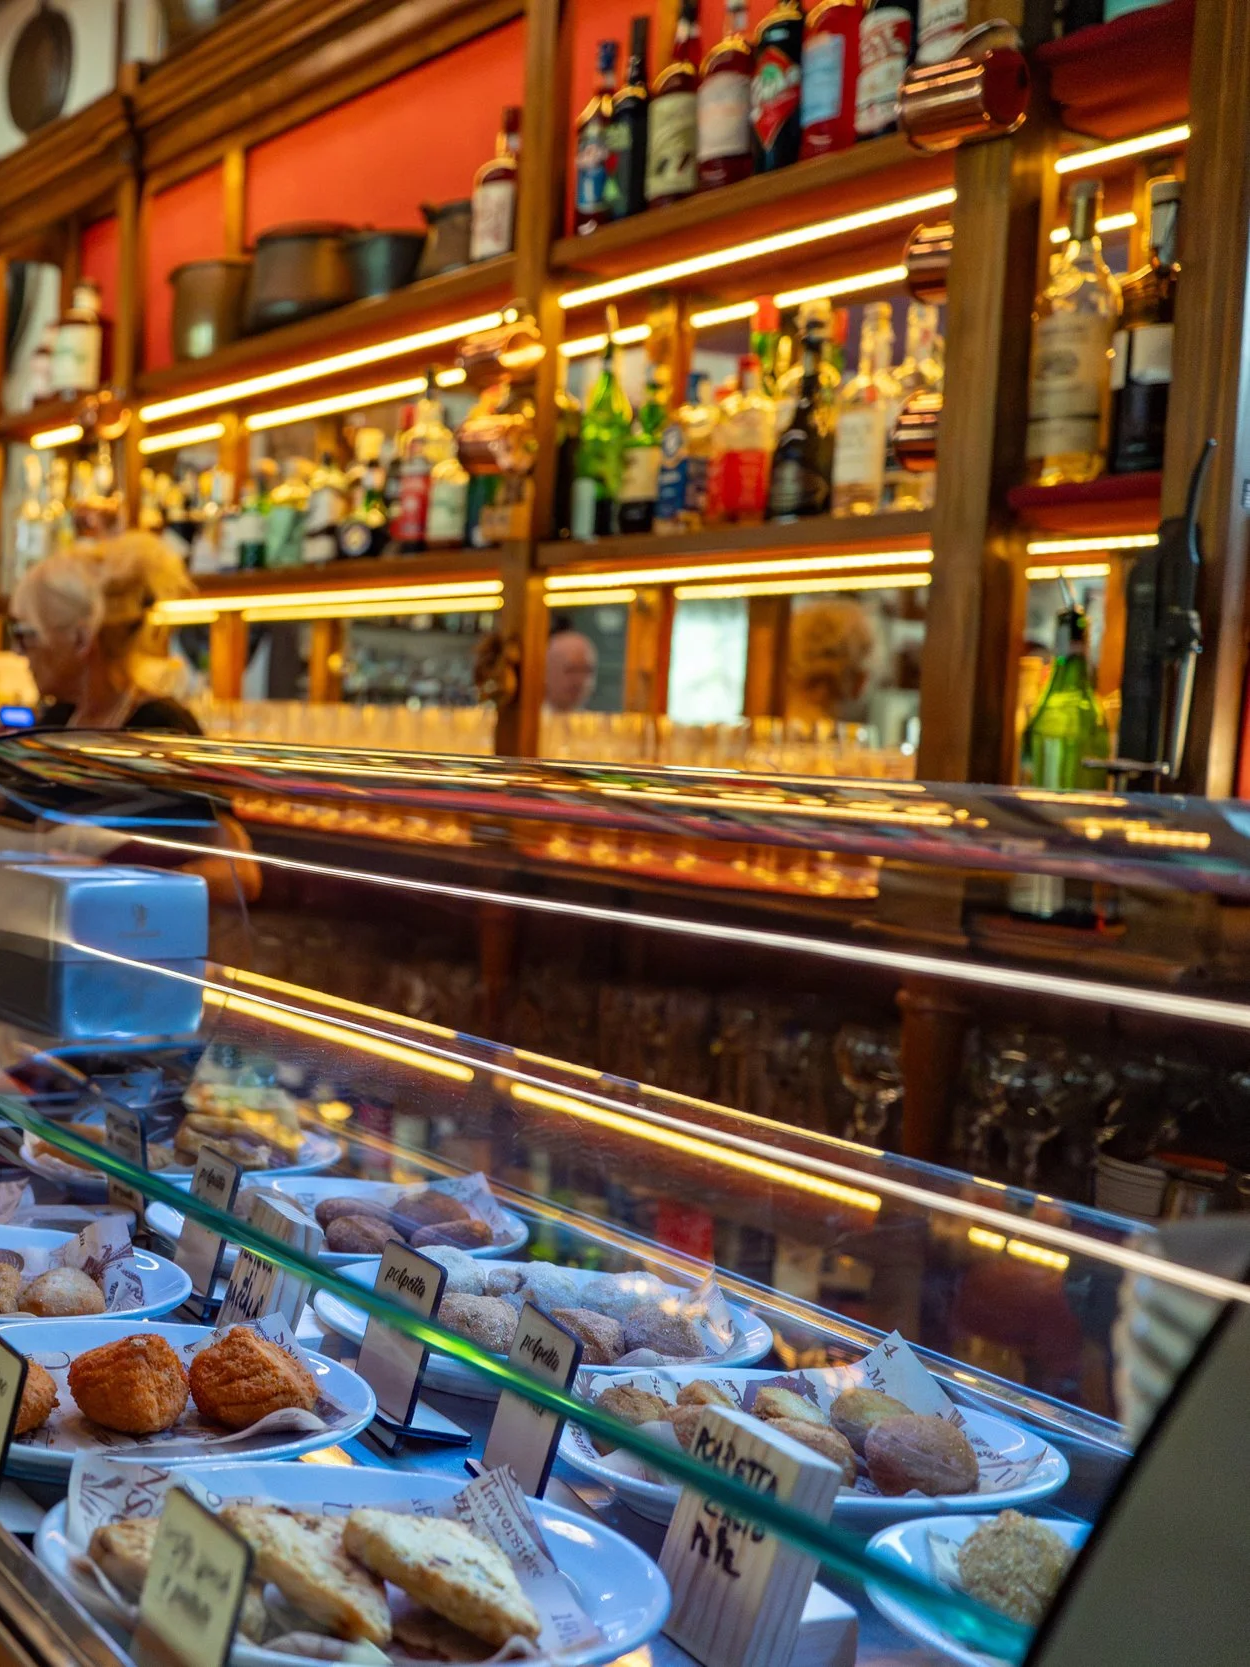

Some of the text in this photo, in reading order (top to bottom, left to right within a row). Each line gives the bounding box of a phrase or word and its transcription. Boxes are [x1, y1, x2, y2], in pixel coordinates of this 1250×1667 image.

[384, 1264, 426, 1300] polpetta
[519, 1333, 560, 1374] polpetta
[695, 1427, 778, 1494] POLPETTA
